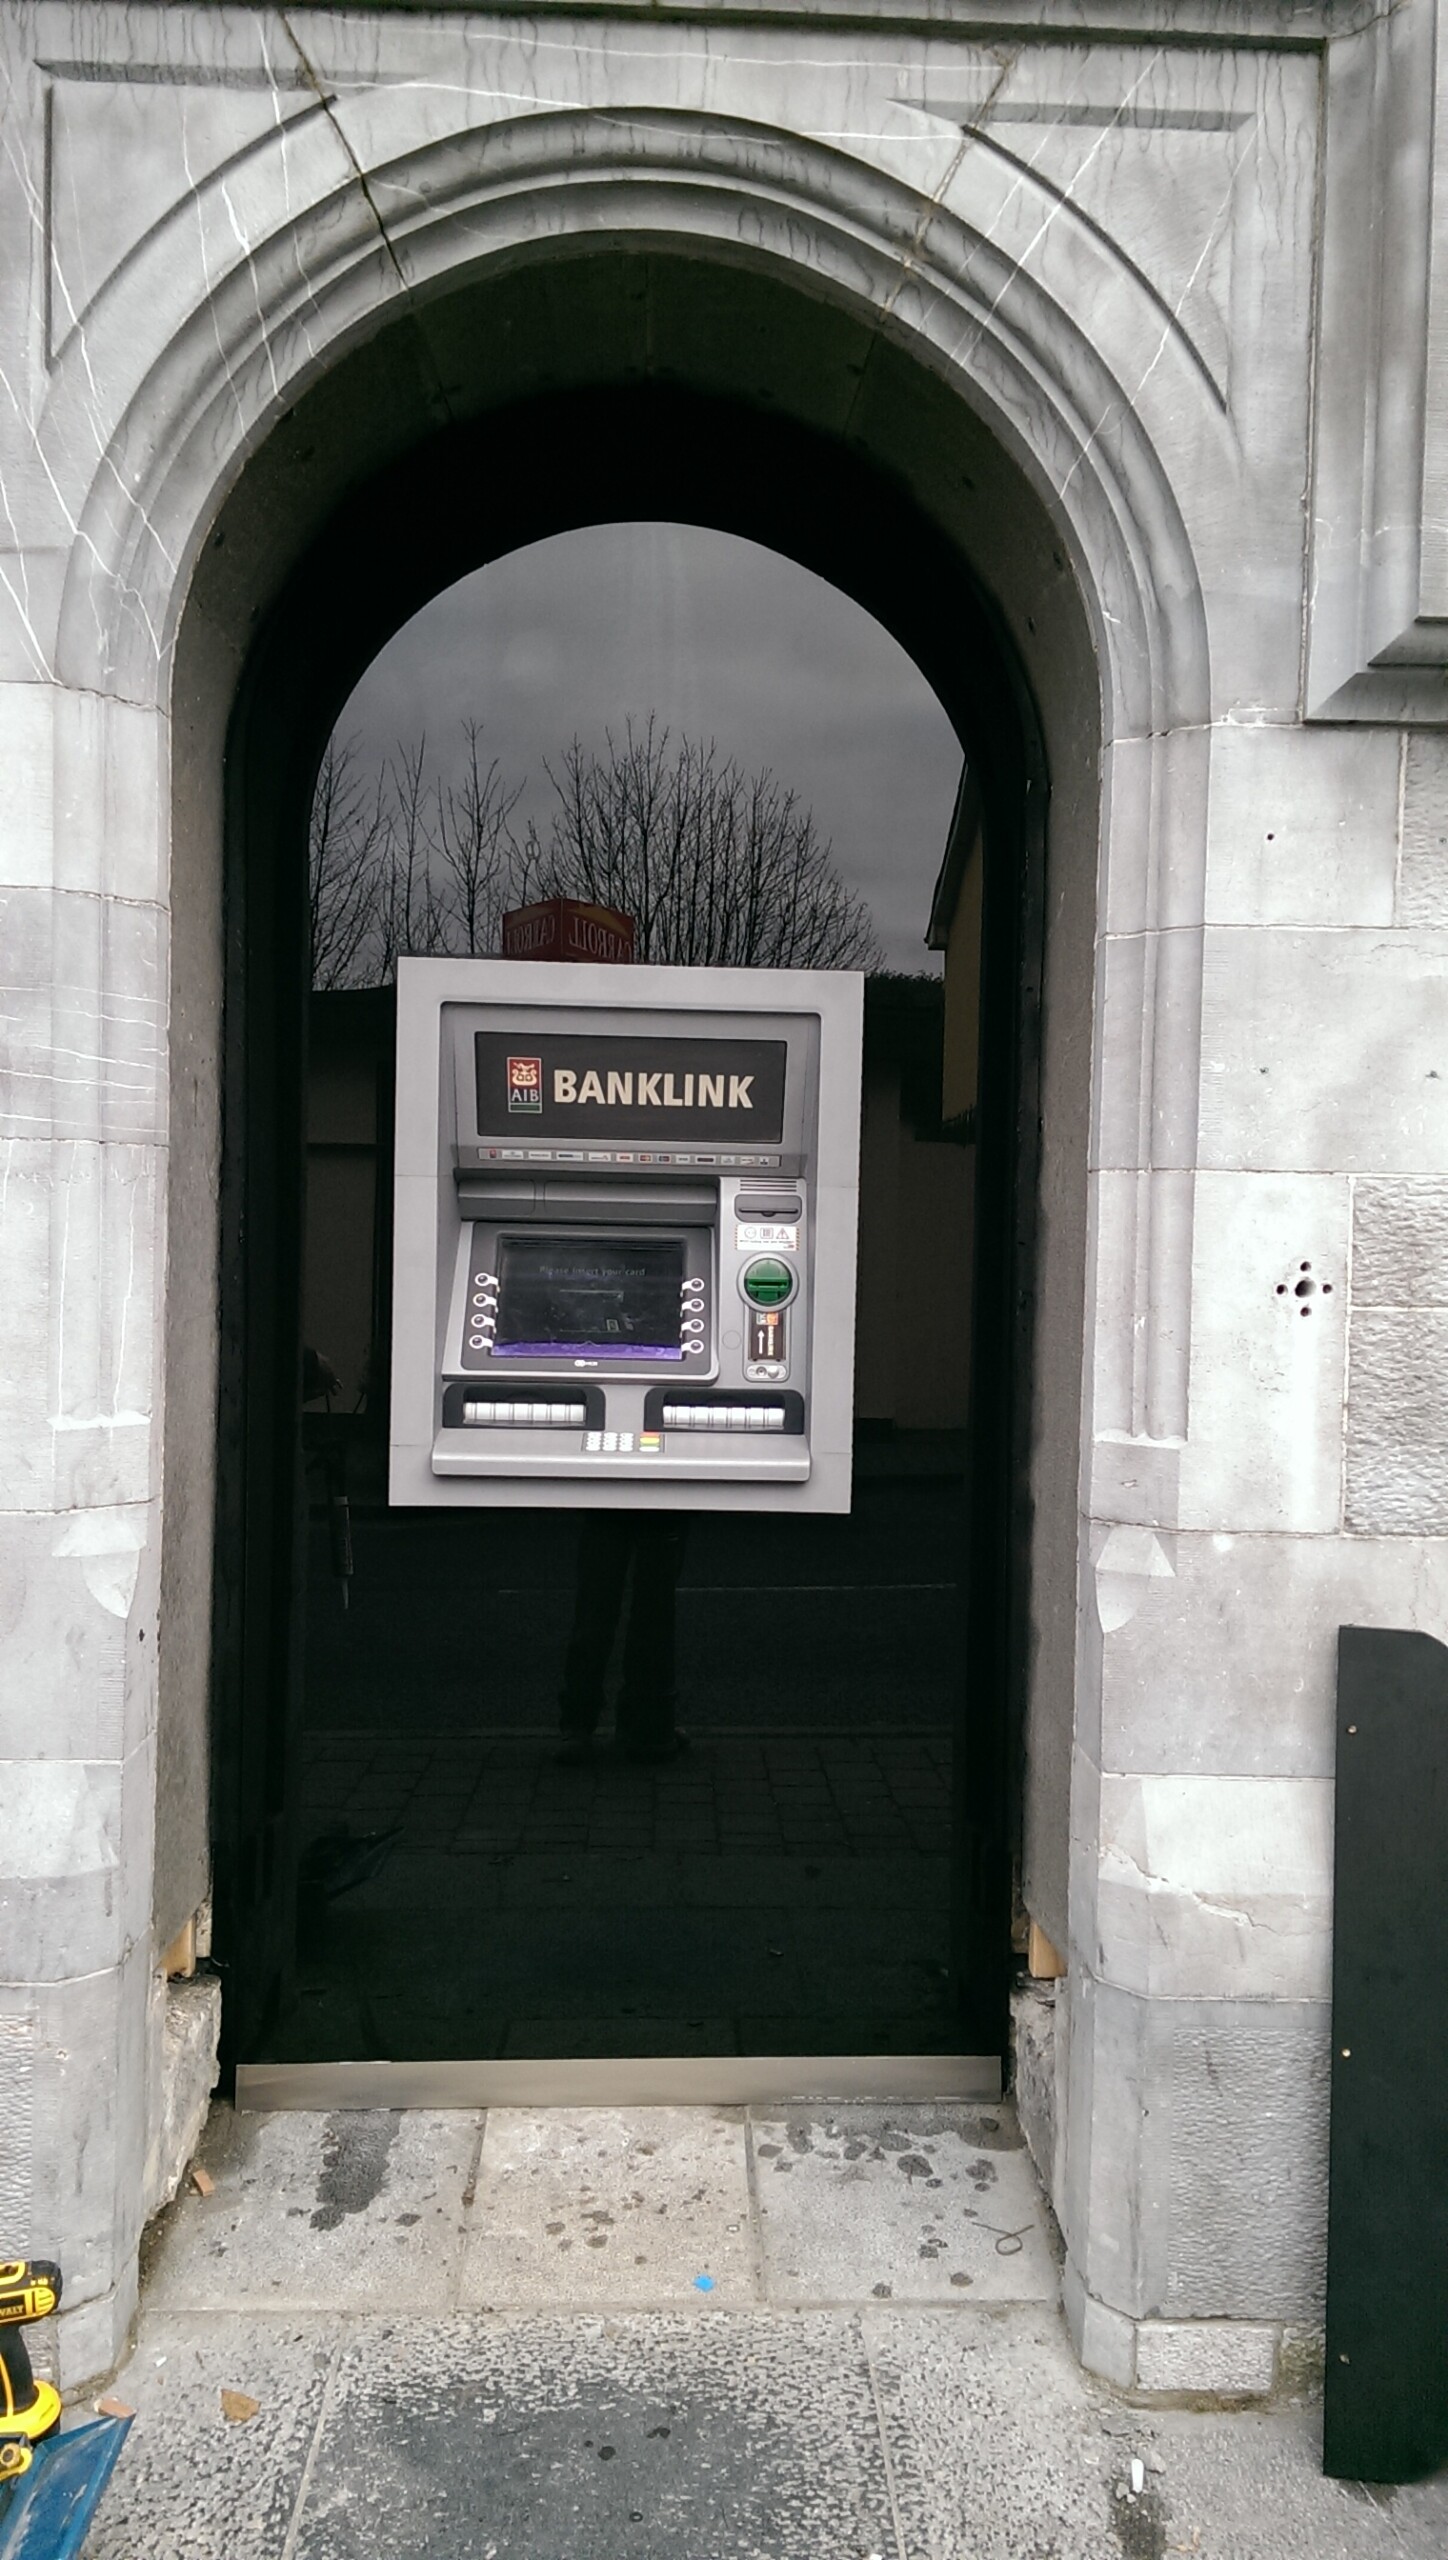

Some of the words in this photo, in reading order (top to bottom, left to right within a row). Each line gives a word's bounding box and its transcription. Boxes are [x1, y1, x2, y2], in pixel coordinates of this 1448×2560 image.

[510, 1088, 540, 1102] AIB
[553, 1069, 755, 1109] BANKLINK
[539, 1265, 569, 1275] Please
[602, 1268, 623, 1278] your
[625, 1267, 646, 1276] card
